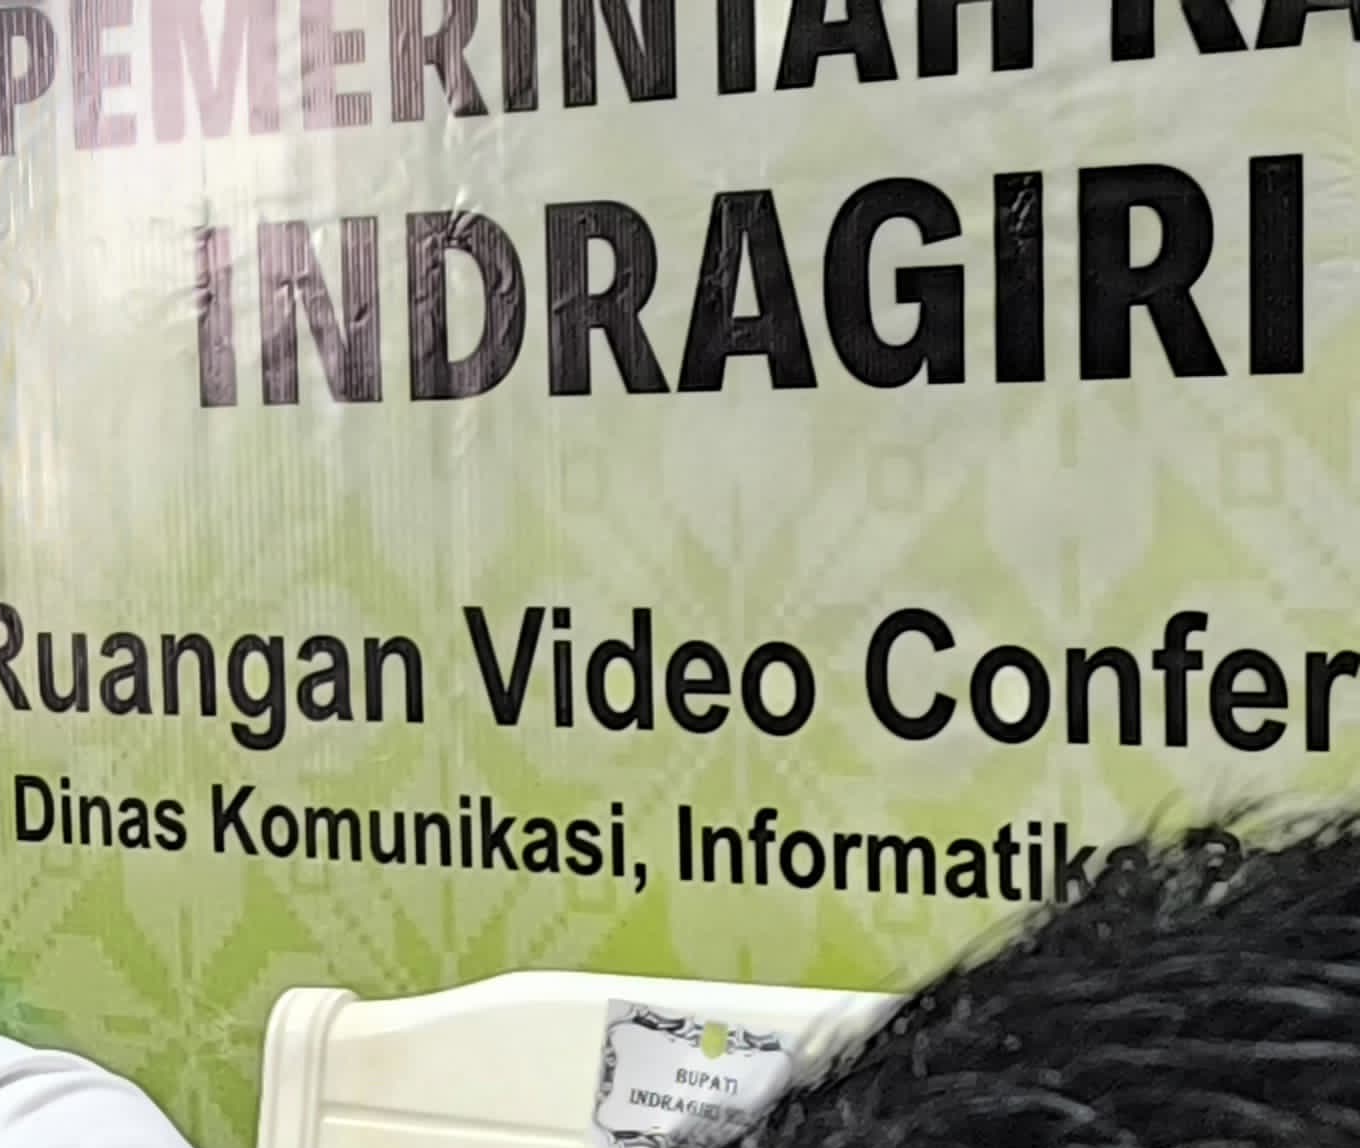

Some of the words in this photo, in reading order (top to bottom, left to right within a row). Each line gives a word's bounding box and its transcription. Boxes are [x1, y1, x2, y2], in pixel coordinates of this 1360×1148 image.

[193, 154, 1304, 408] INDRAGIRI
[462, 605, 816, 737] Video
[864, 607, 1360, 752] Confer
[14, 774, 187, 851] Dinas
[210, 783, 648, 894] Komunikasi,
